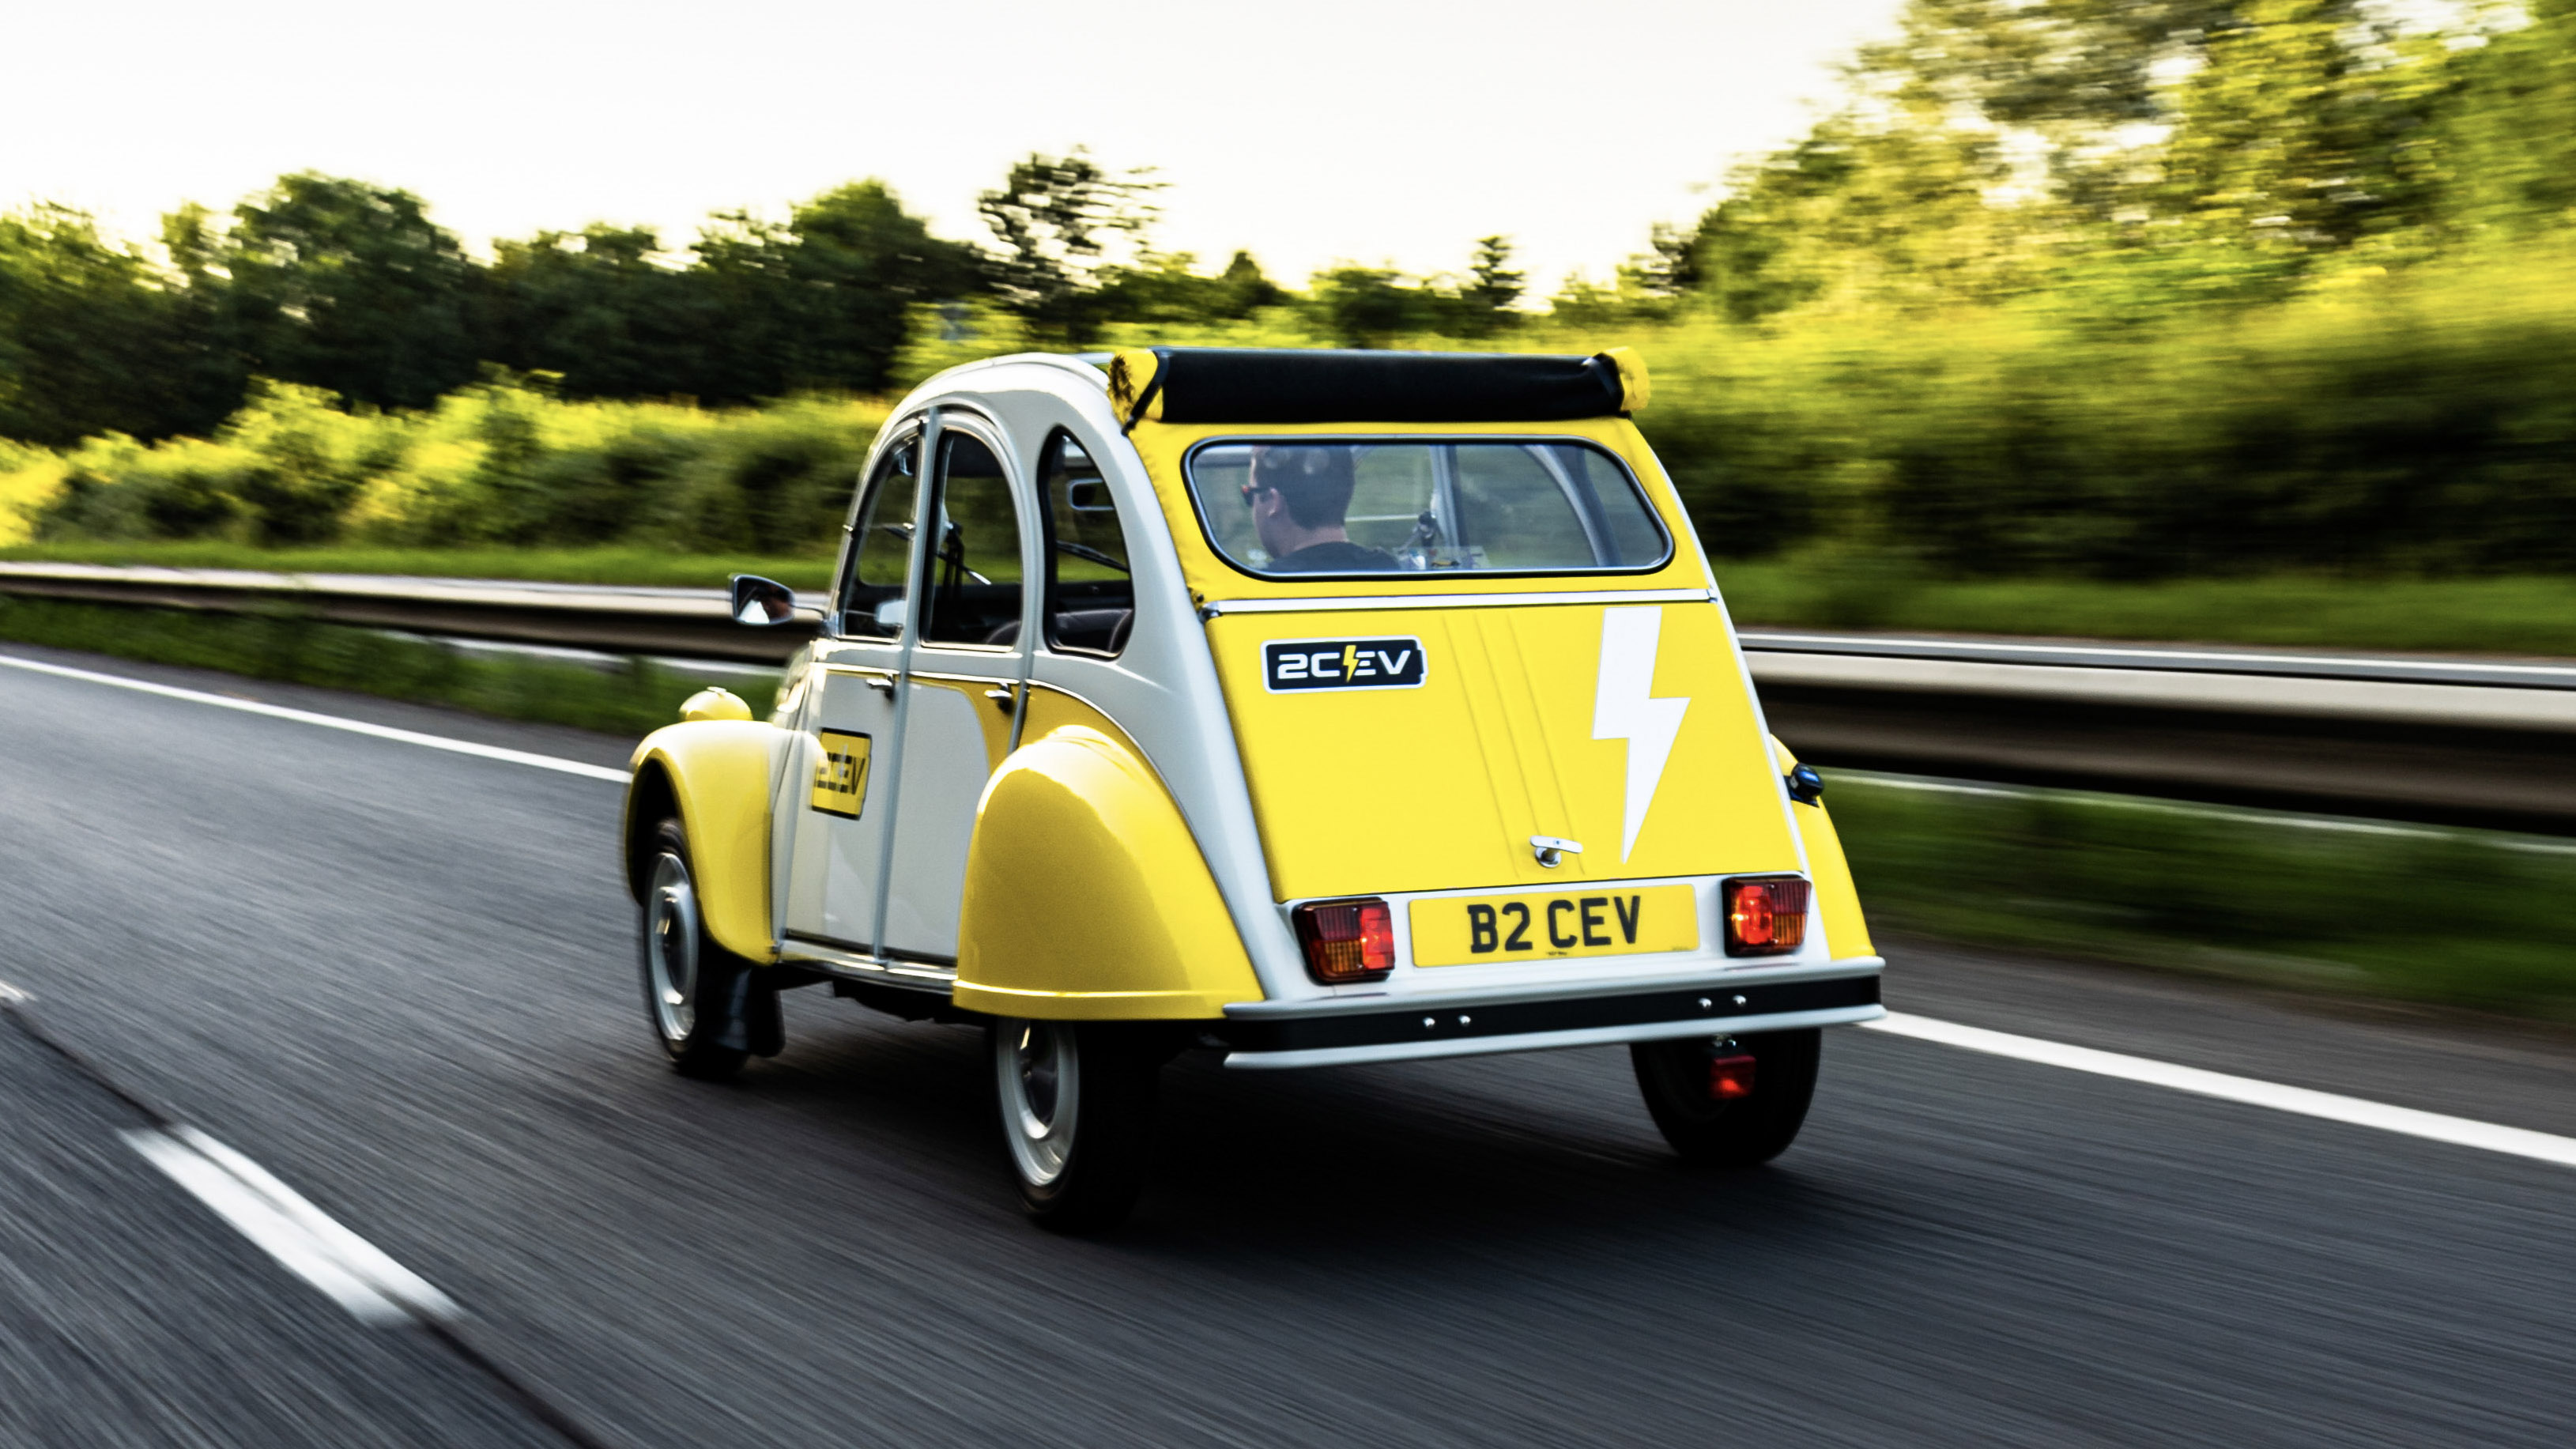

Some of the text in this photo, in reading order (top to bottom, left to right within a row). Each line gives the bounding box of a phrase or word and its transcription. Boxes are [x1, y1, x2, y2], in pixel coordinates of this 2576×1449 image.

[1277, 651, 1411, 680] 2CEV
[1467, 896, 1640, 953] B2 CEV
